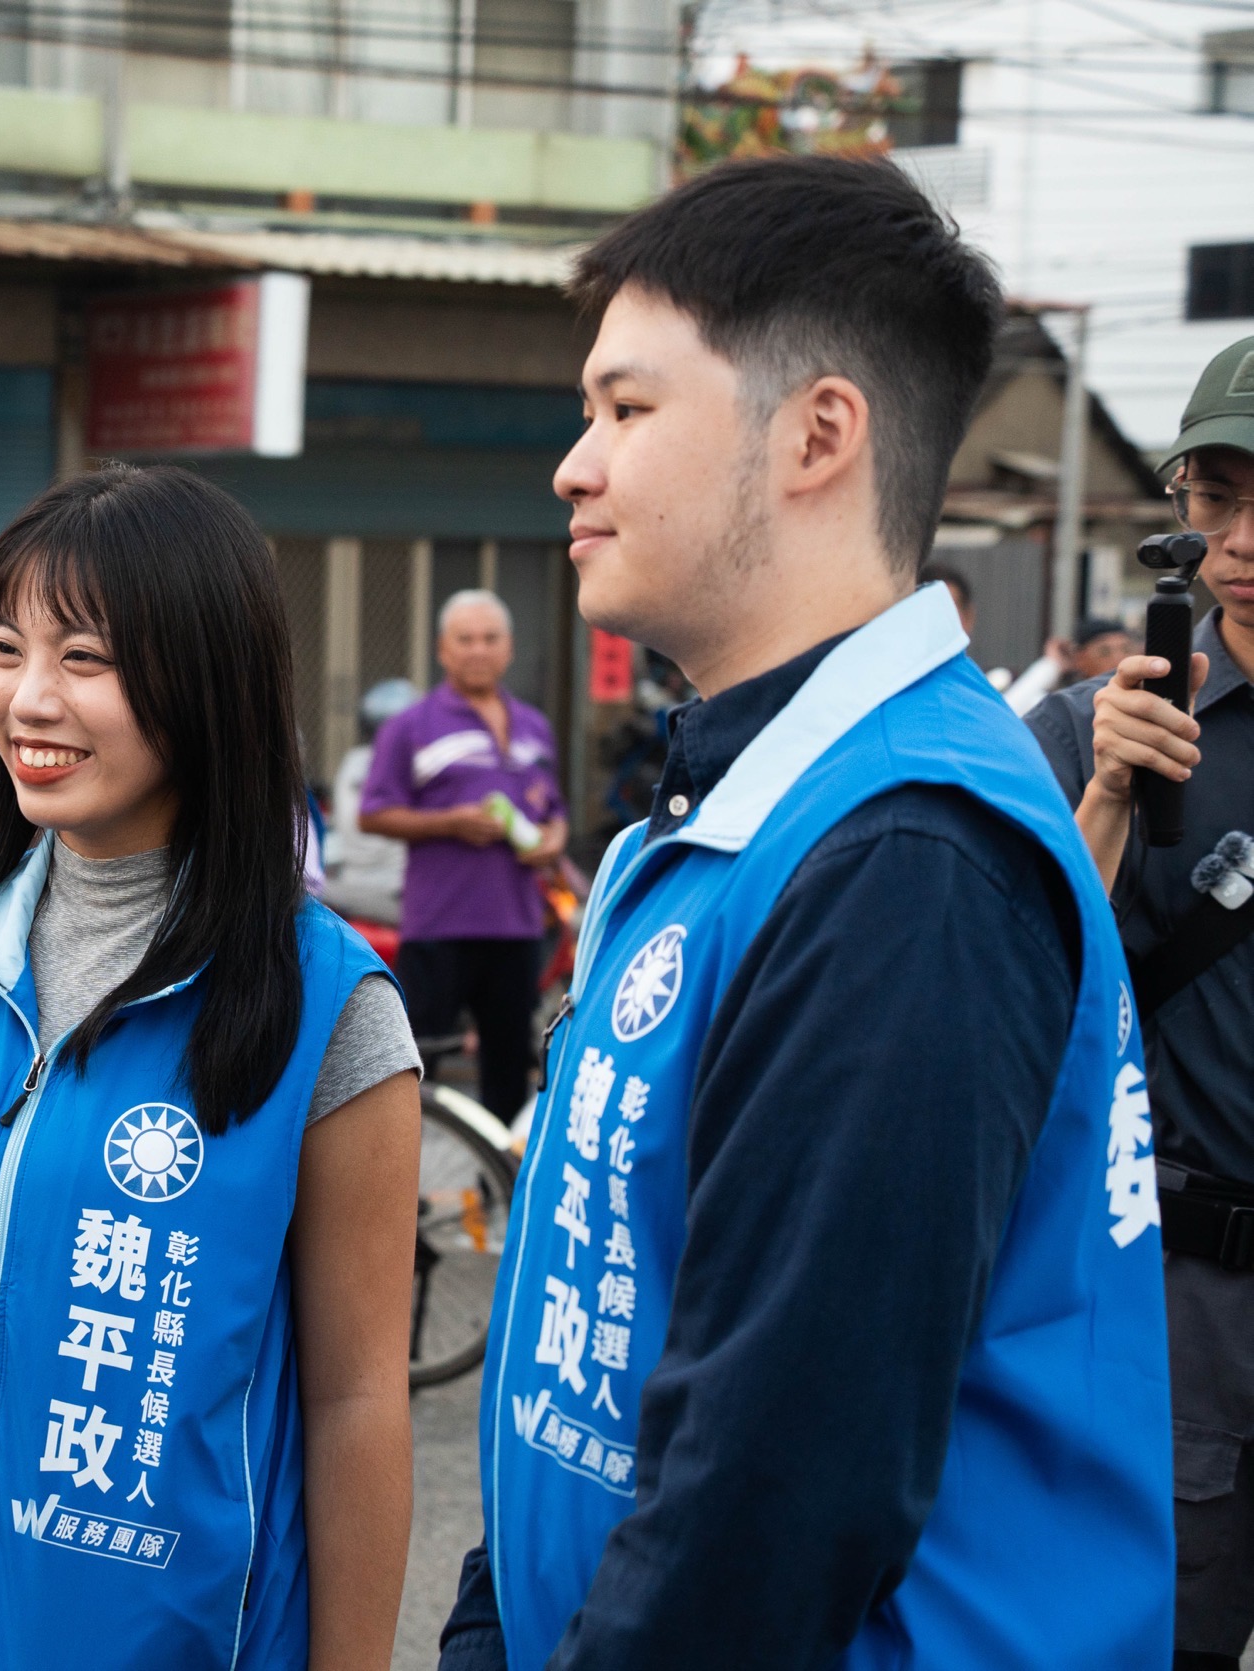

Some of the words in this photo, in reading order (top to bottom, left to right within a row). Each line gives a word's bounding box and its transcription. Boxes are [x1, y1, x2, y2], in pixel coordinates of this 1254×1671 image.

[39, 1208, 152, 1494] 魏平政
[535, 1047, 616, 1395] 魏平政
[591, 1075, 650, 1421] 彰化縣長候選人
[126, 1230, 200, 1508] 彰化縣長候選人
[52, 1513, 166, 1559] 服務團隊
